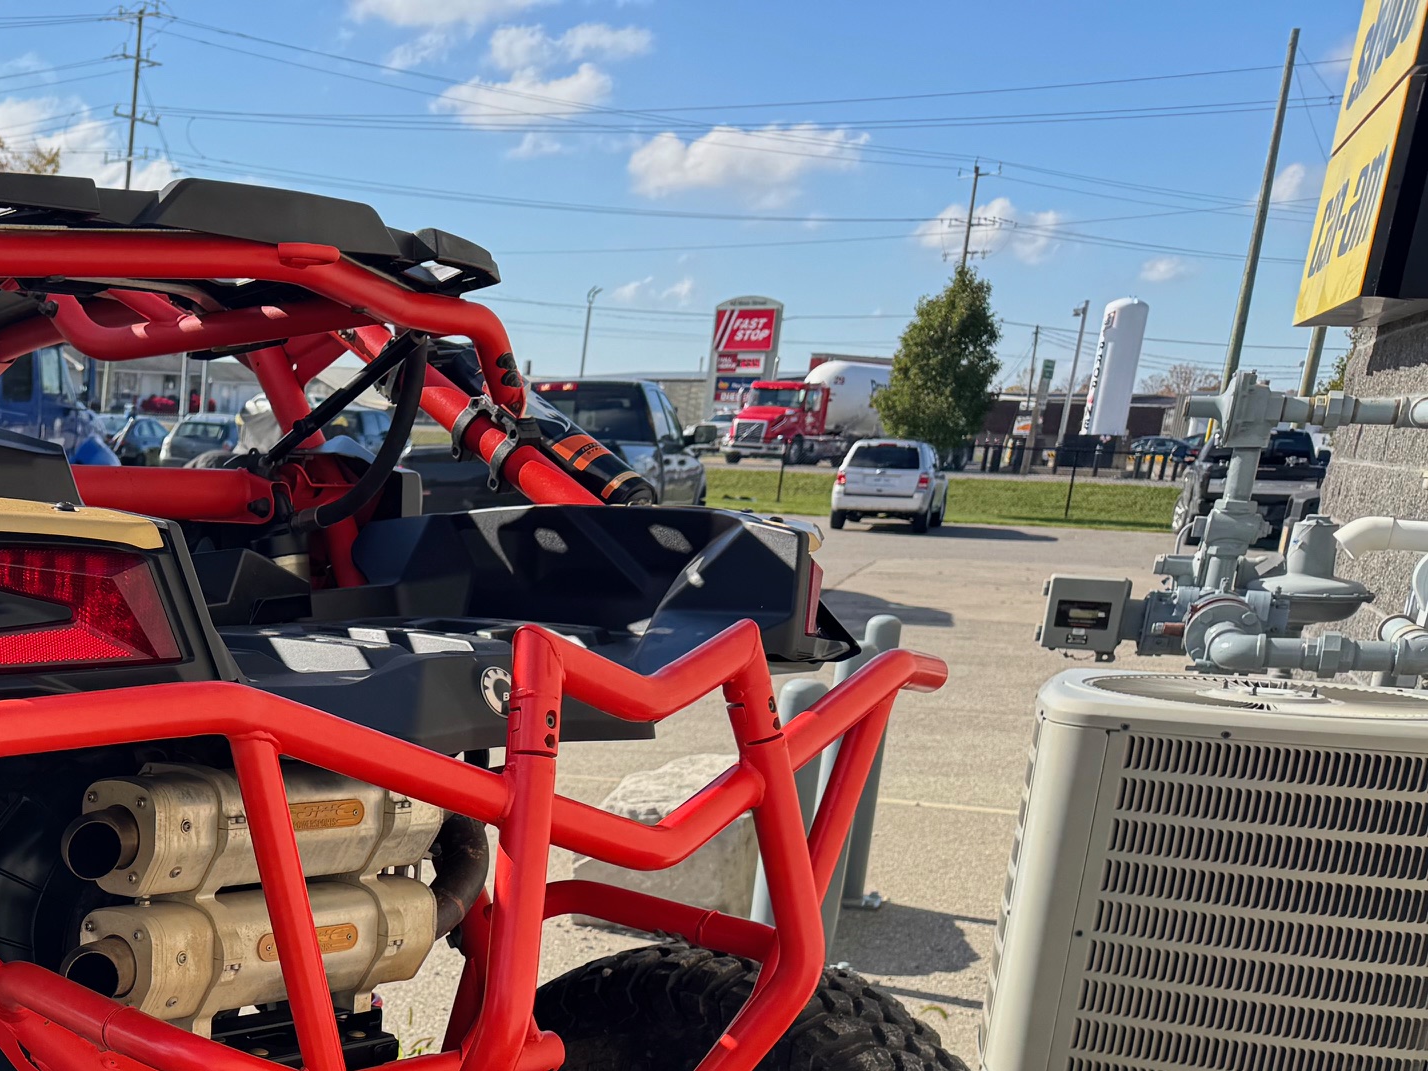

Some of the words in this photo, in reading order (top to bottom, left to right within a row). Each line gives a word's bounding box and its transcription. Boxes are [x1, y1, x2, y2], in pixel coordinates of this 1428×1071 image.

[1308, 144, 1389, 278] can-am
[733, 318, 768, 330] FAST
[734, 329, 771, 342] STOP
